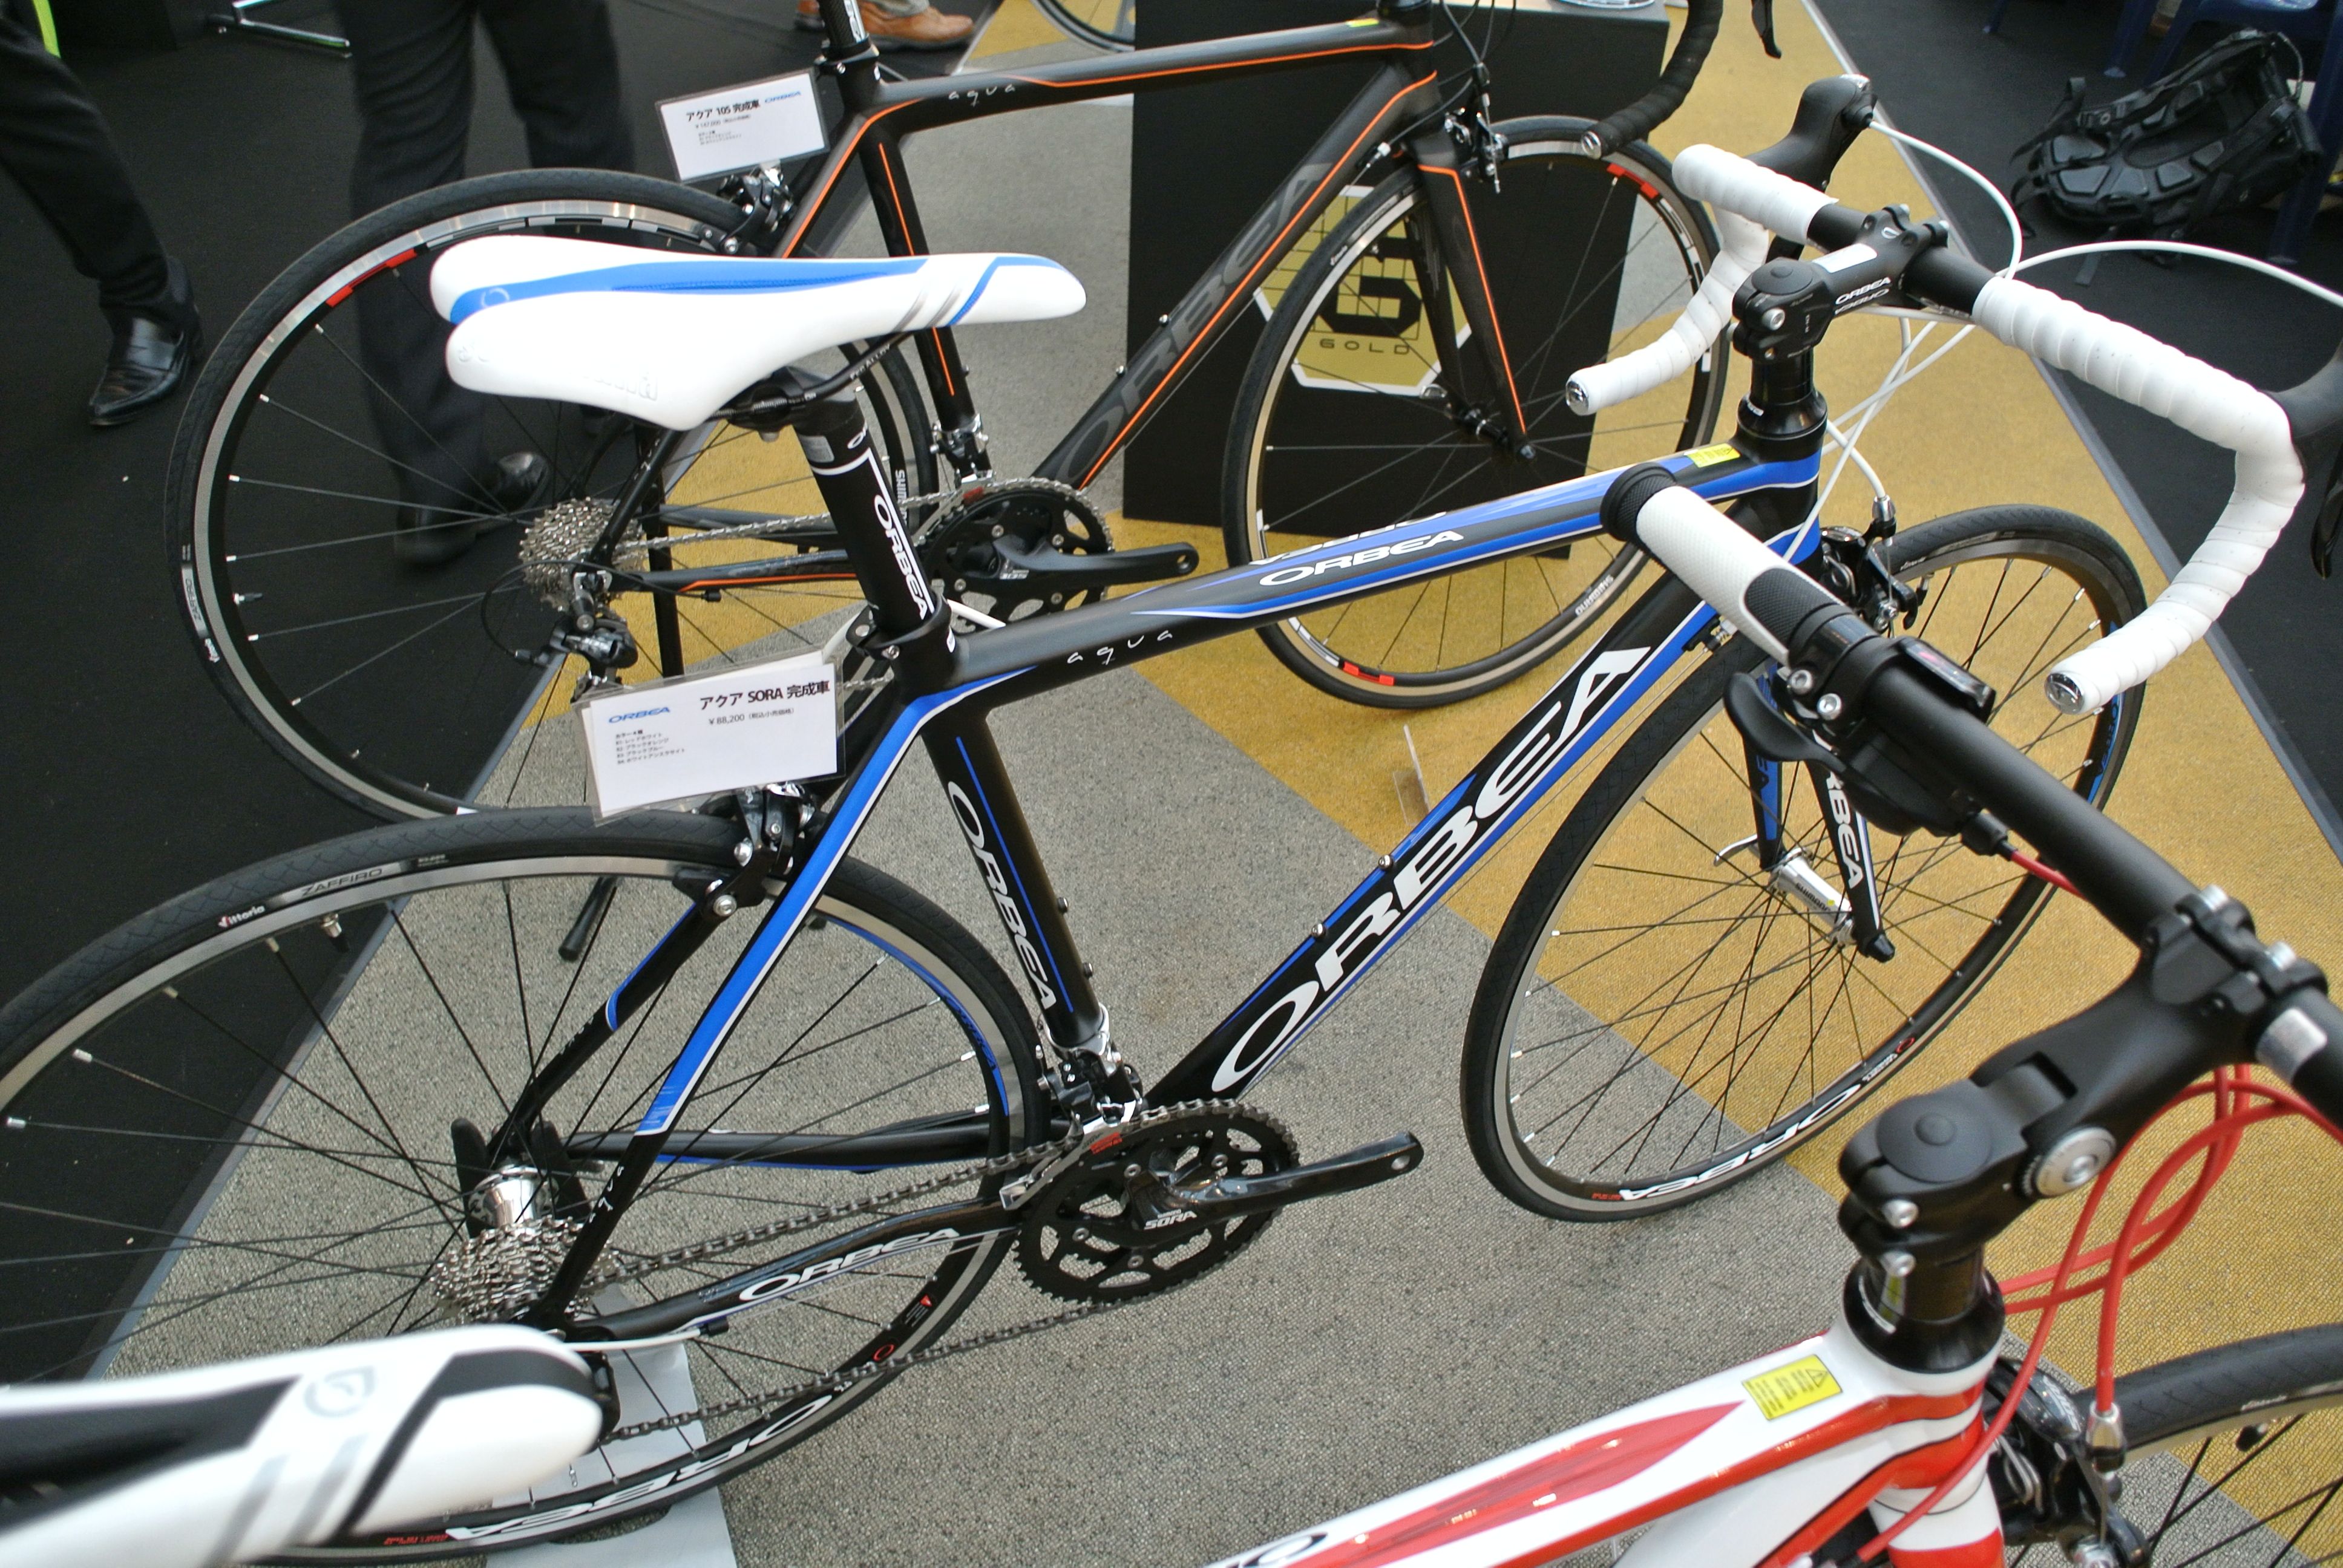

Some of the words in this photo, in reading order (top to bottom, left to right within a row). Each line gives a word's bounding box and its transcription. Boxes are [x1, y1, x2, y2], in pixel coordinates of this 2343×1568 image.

[686, 108, 713, 122] アクア
[716, 106, 732, 116] 105
[948, 84, 1016, 107] aqua
[1836, 276, 1891, 305] ORBEA
[874, 494, 928, 621] ORBEA
[1259, 530, 1464, 586] ORBEA
[1066, 630, 1173, 666] aqua
[608, 707, 670, 724] ORBEA
[700, 693, 744, 710] アクア
[747, 688, 784, 704] SORA
[787, 680, 831, 699] 完成車
[948, 780, 1057, 1010] ORBEA
[1211, 646, 1651, 1093] ORBEA
[218, 905, 266, 929] Vittoria
[301, 869, 383, 896] ZAFFIRO
[1619, 1083, 1861, 1201] ORBEA
[1143, 1210, 1198, 1230] SORA
[738, 1227, 960, 1301] ORBEA
[445, 1394, 834, 1541] ORBEA
